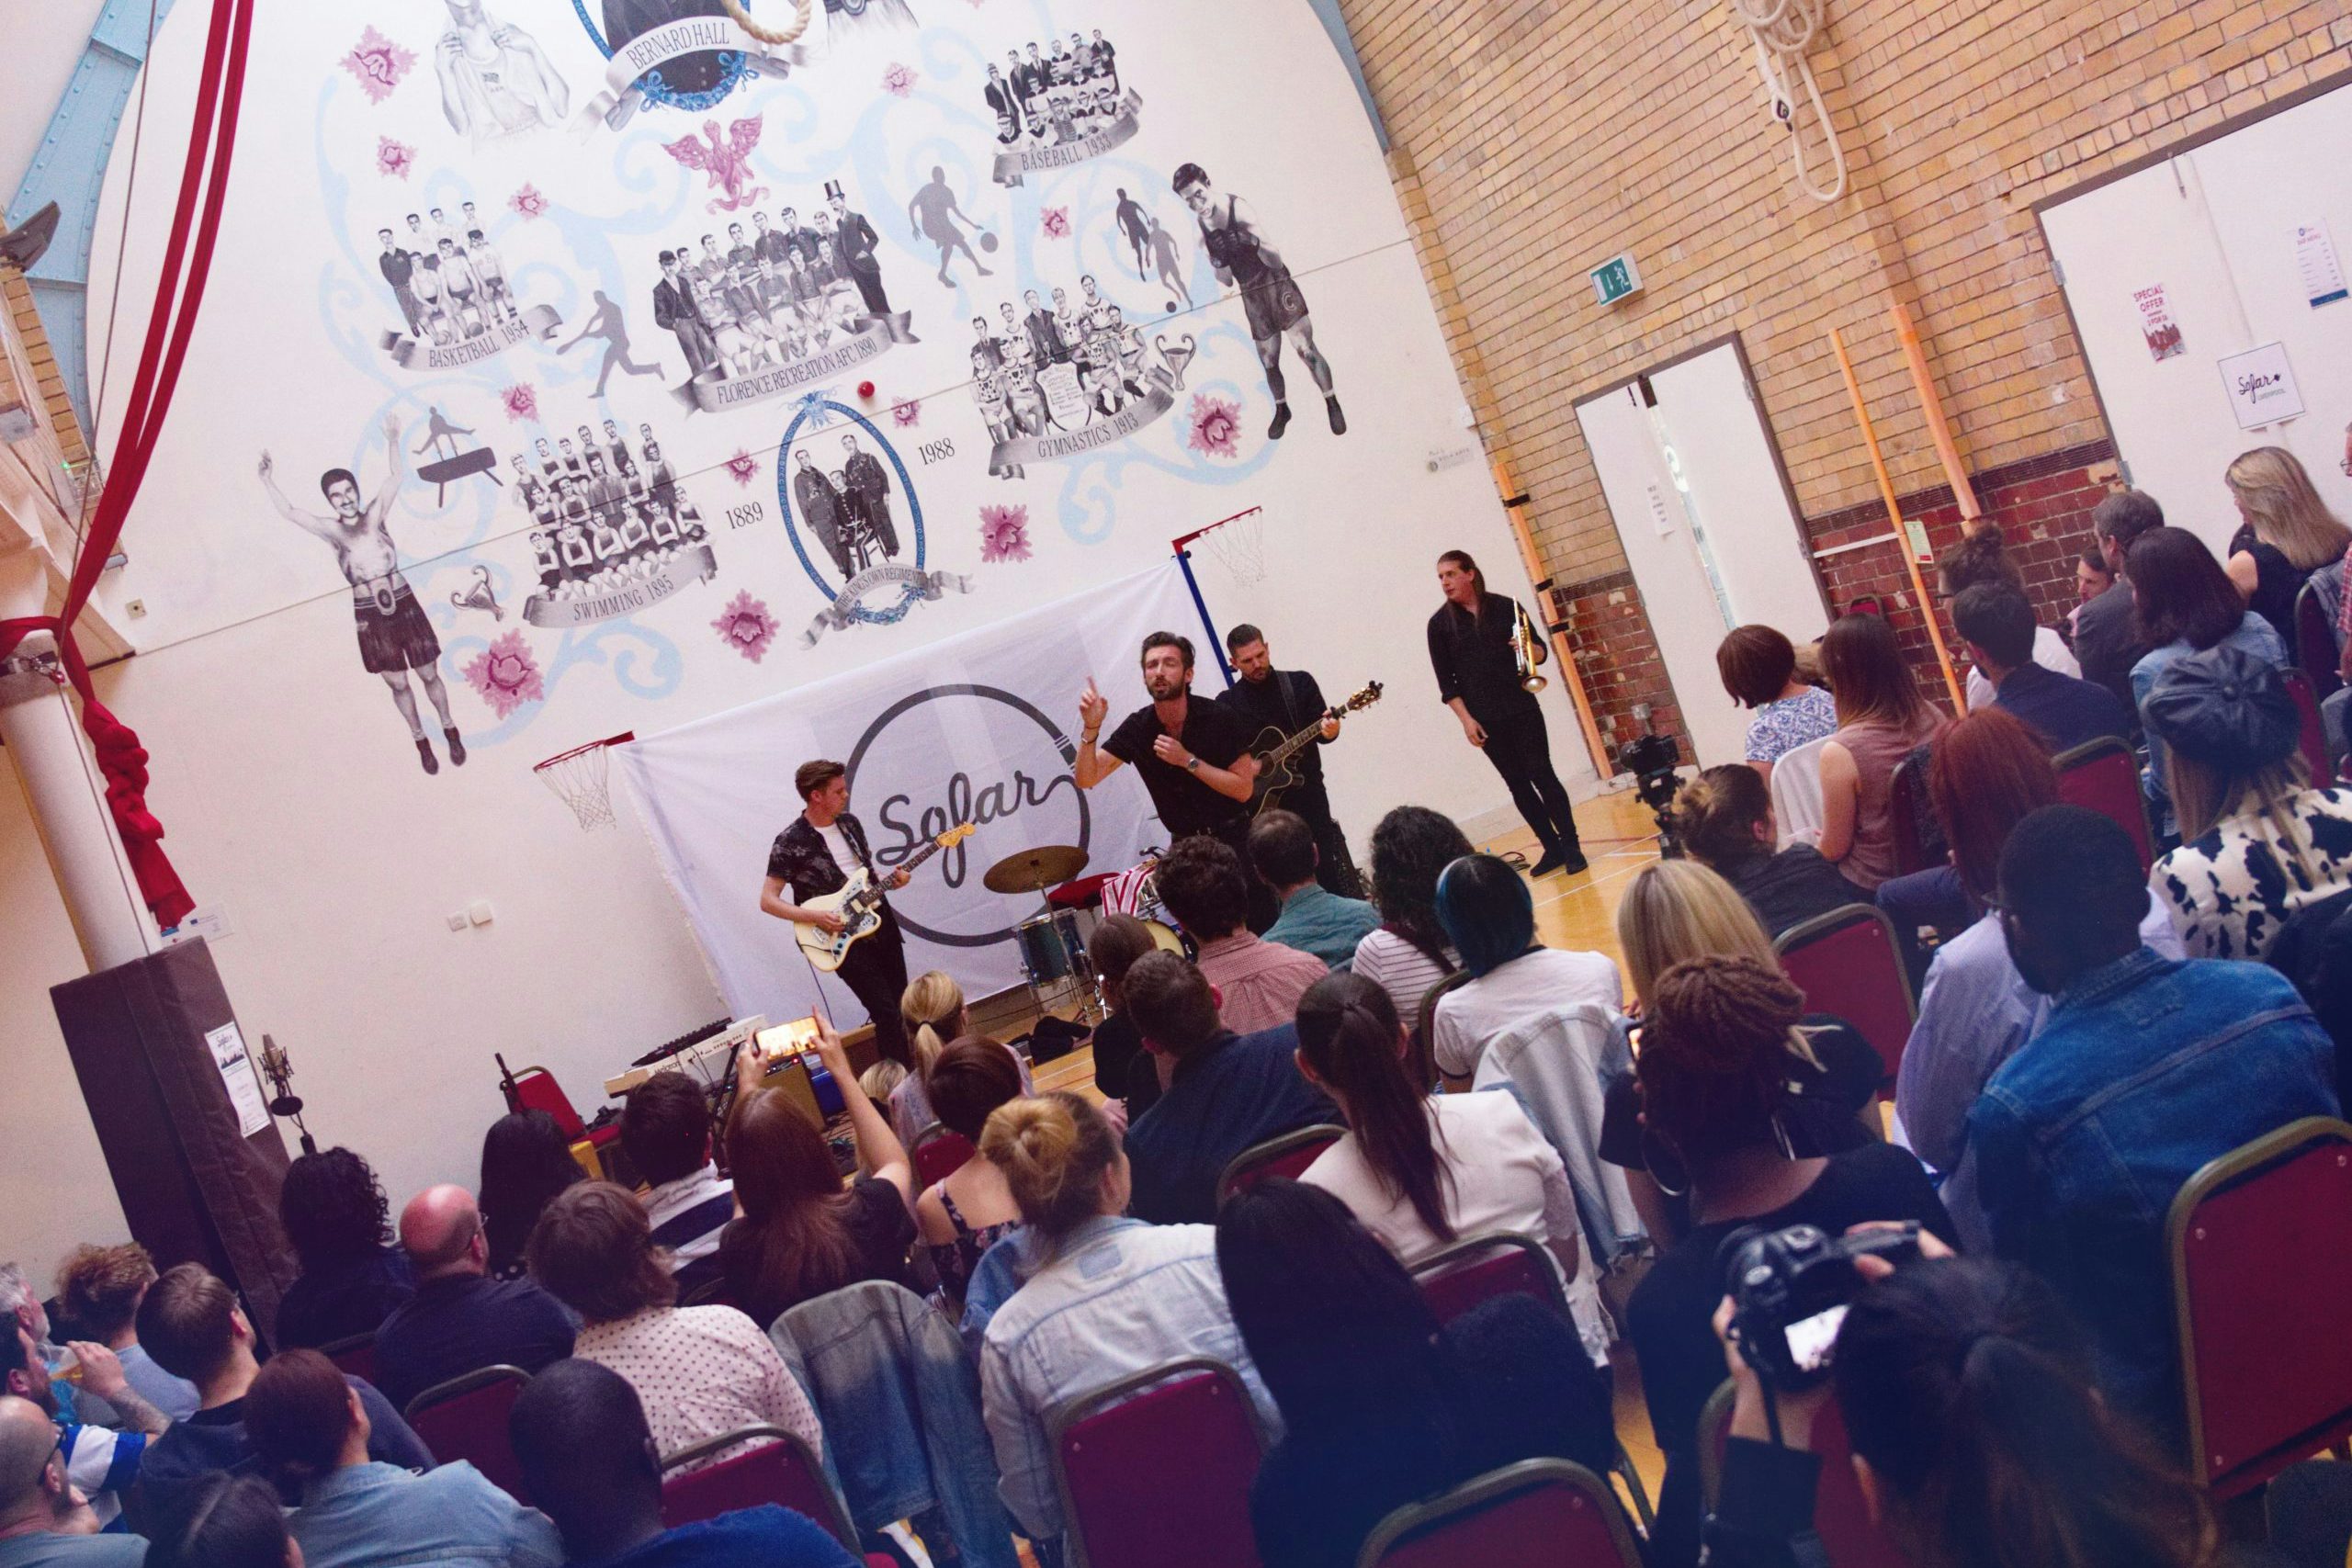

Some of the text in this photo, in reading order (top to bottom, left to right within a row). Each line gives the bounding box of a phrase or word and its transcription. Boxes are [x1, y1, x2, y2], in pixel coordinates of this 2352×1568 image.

[626, 21, 730, 71] BERNARD HALL
[1021, 134, 1113, 172] BASEBALL 1933
[2133, 283, 2165, 302] SPECIAL
[2140, 297, 2165, 312] OFFER
[428, 319, 529, 368] BASKETBALL 1954
[717, 336, 878, 405] FLORENCE RECREATION AFC 1890
[2237, 373, 2275, 404] Sofar
[918, 437, 956, 466] 1988
[1037, 412, 1140, 458] GYMNASTICS 1913
[725, 501, 764, 530] 1889
[573, 574, 675, 622] SWIMMING 1895
[876, 770, 1049, 888] Sofar
